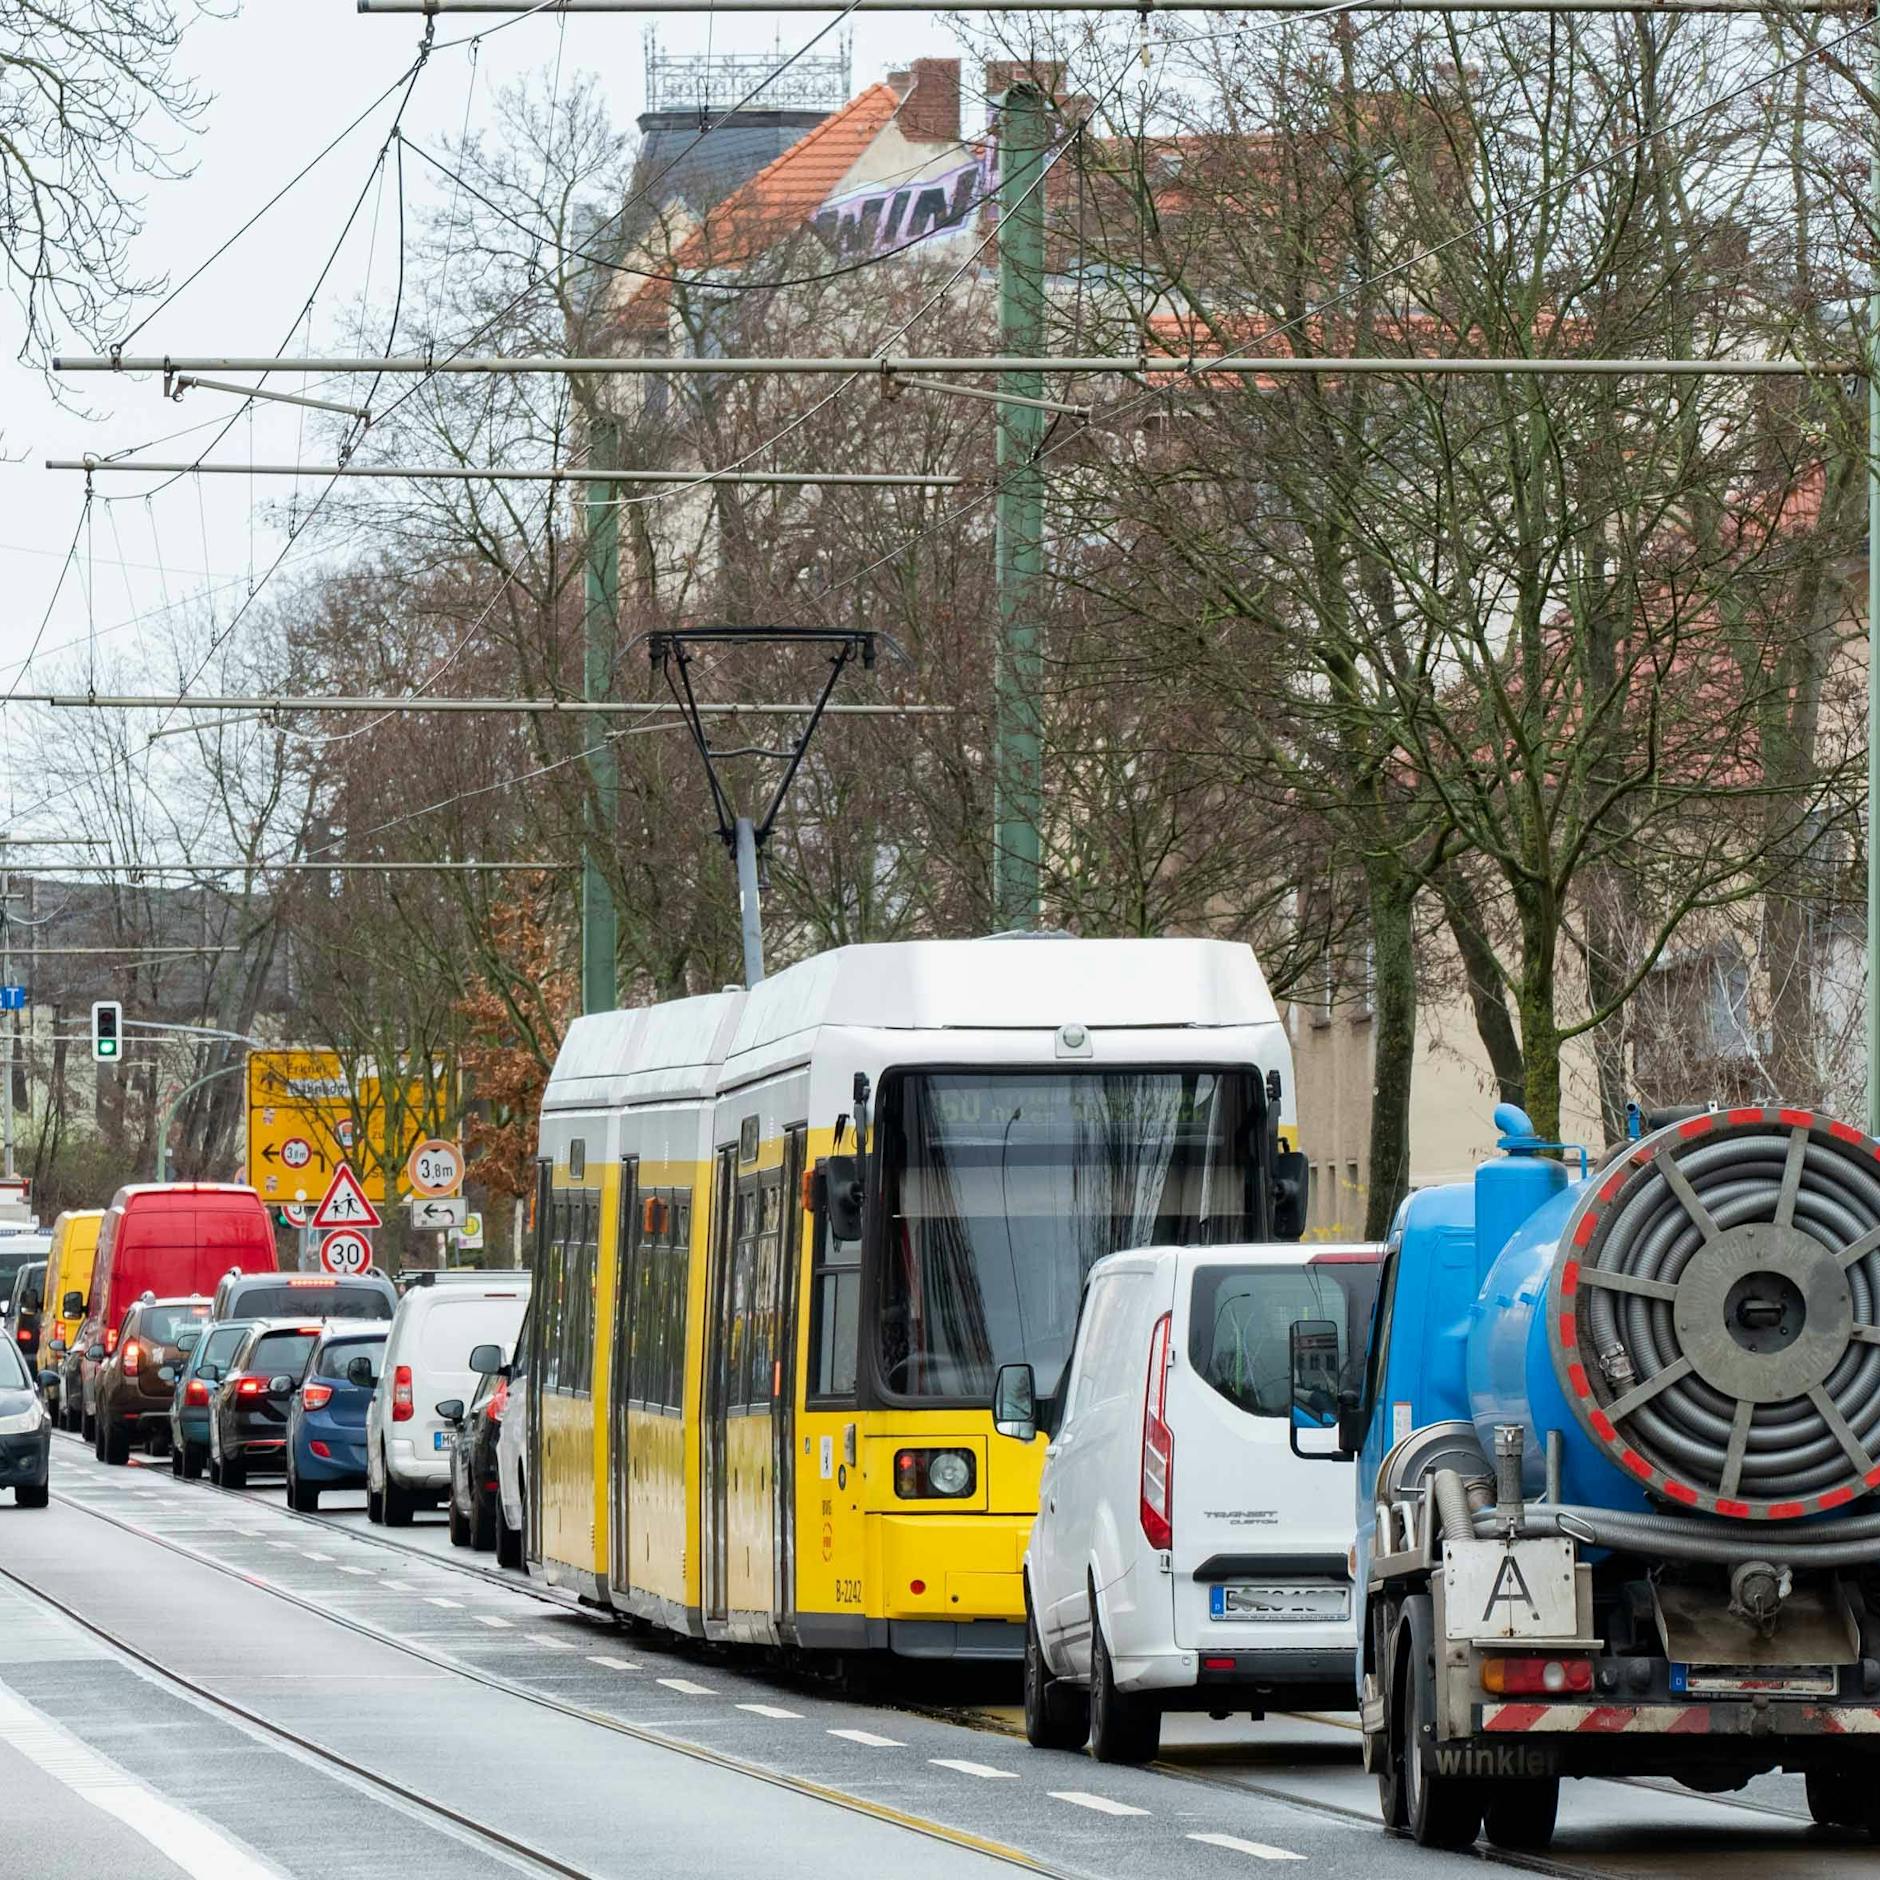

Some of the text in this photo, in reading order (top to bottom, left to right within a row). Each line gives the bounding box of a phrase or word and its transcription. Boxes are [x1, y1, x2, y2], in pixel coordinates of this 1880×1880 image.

[332, 1243, 359, 1264] 30
[836, 1580, 861, 1603] B-2242
[1482, 1555, 1541, 1622] A
